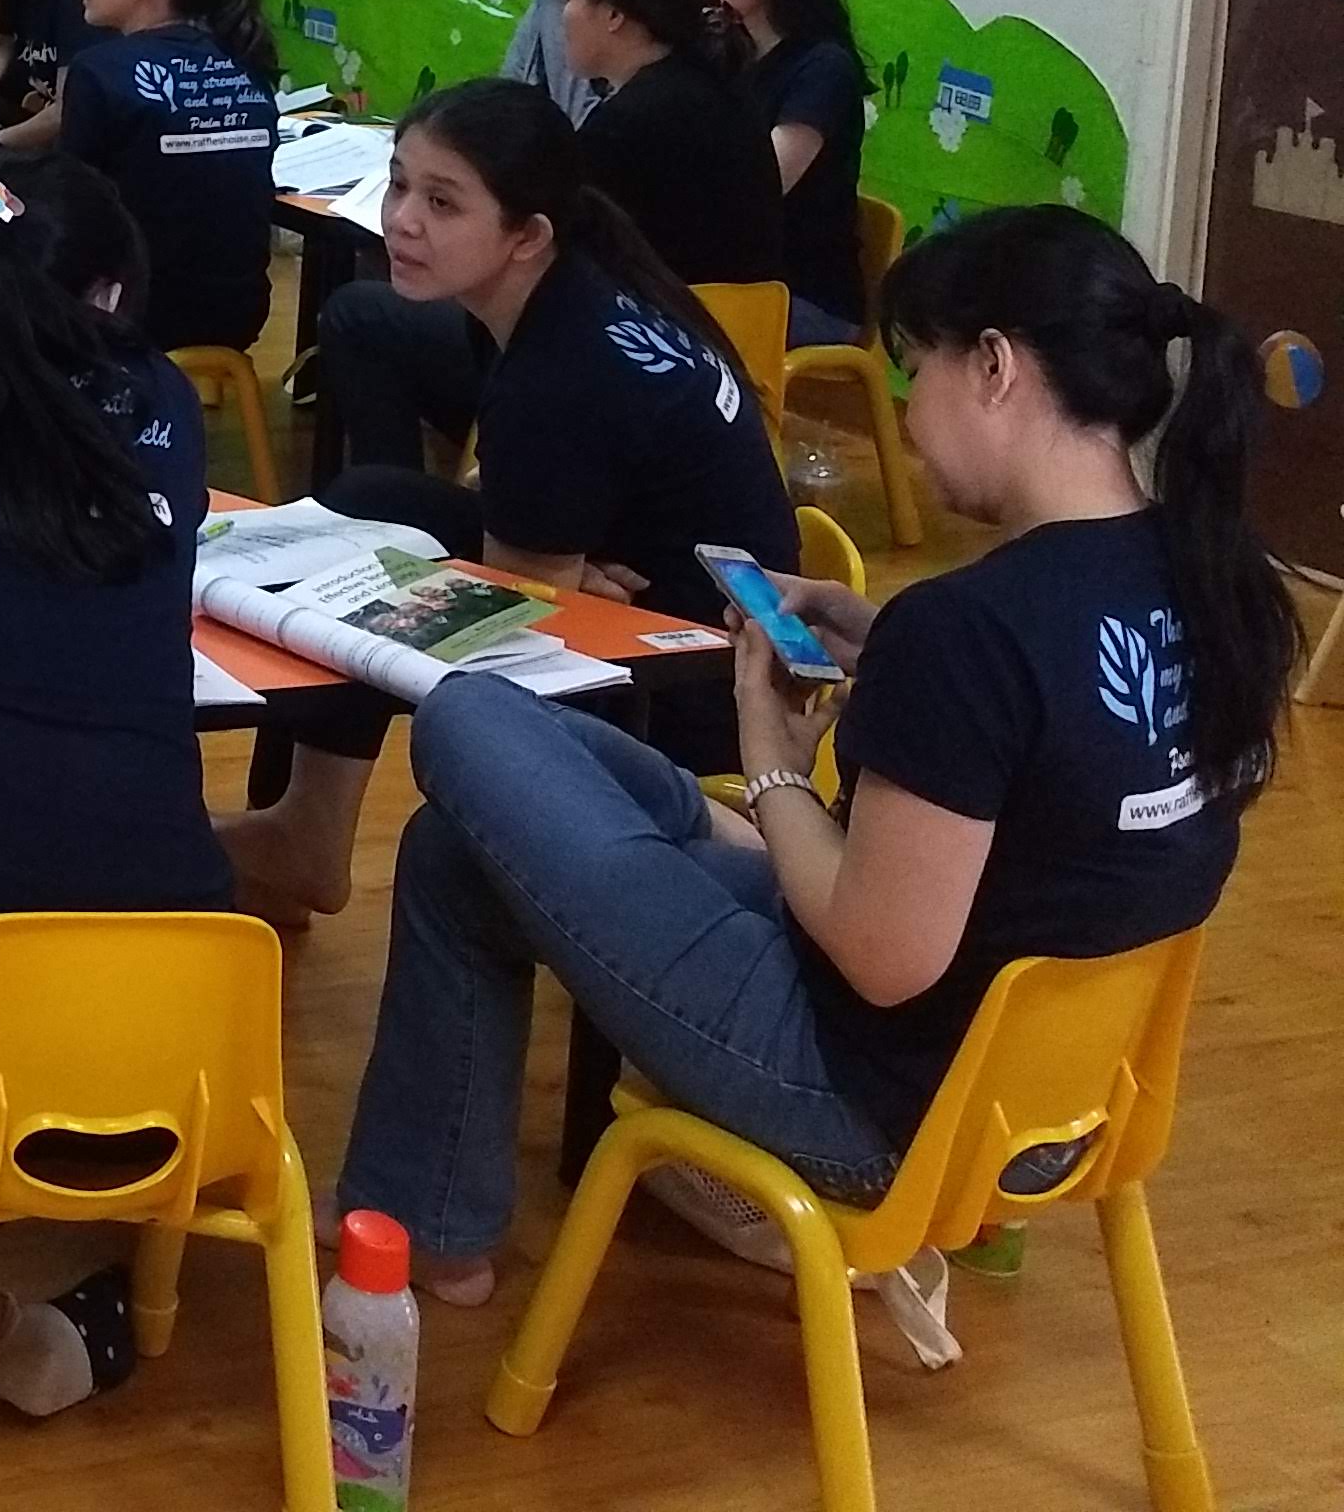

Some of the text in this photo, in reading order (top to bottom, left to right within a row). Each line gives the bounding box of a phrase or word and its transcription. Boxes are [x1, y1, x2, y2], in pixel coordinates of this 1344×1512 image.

[170, 55, 235, 74] The Lord
[178, 80, 198, 94] my
[183, 92, 209, 108] and
[212, 95, 233, 110] my
[189, 116, 221, 131] Psalm
